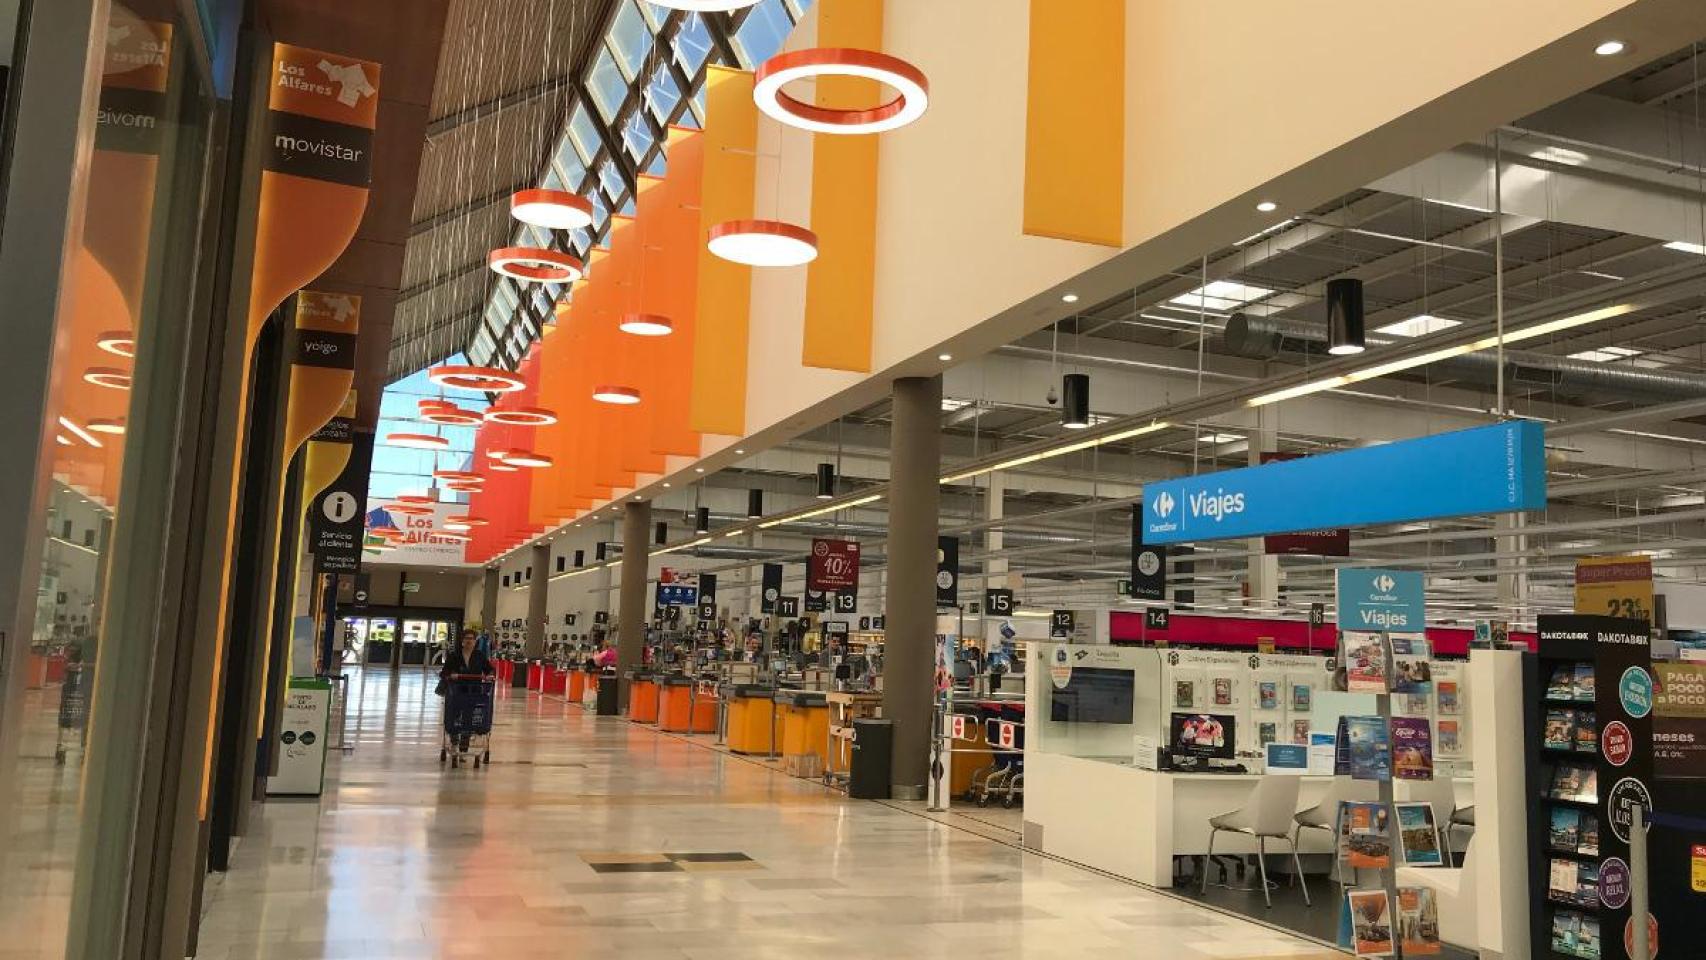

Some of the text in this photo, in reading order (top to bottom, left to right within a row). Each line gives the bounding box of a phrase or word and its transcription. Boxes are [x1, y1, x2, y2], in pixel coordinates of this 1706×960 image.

[278, 60, 305, 76] Los
[278, 75, 333, 96] Alfares
[275, 134, 363, 161] movistar
[304, 340, 338, 355] yoigo
[1189, 487, 1245, 522] Viajes
[406, 515, 433, 528] Los
[1149, 523, 1178, 533] Carrefour
[321, 531, 353, 540] Servicio
[406, 530, 461, 545] Alfares
[838, 595, 854, 609] 13
[989, 594, 1009, 611] 15
[1369, 593, 1398, 601] Carrefour
[704, 606, 712, 617] 9
[783, 601, 794, 614] 11
[1056, 613, 1070, 625] 12
[1149, 612, 1167, 626] 14
[1312, 609, 1322, 624] 16
[1360, 609, 1407, 628] Viajes
[1540, 632, 1589, 640] DAKOTABOX
[1597, 632, 1649, 645] DAKOTABOX
[1667, 672, 1705, 683] PAGA
[1667, 683, 1706, 693] POCO
[1668, 694, 1706, 705] POCO
